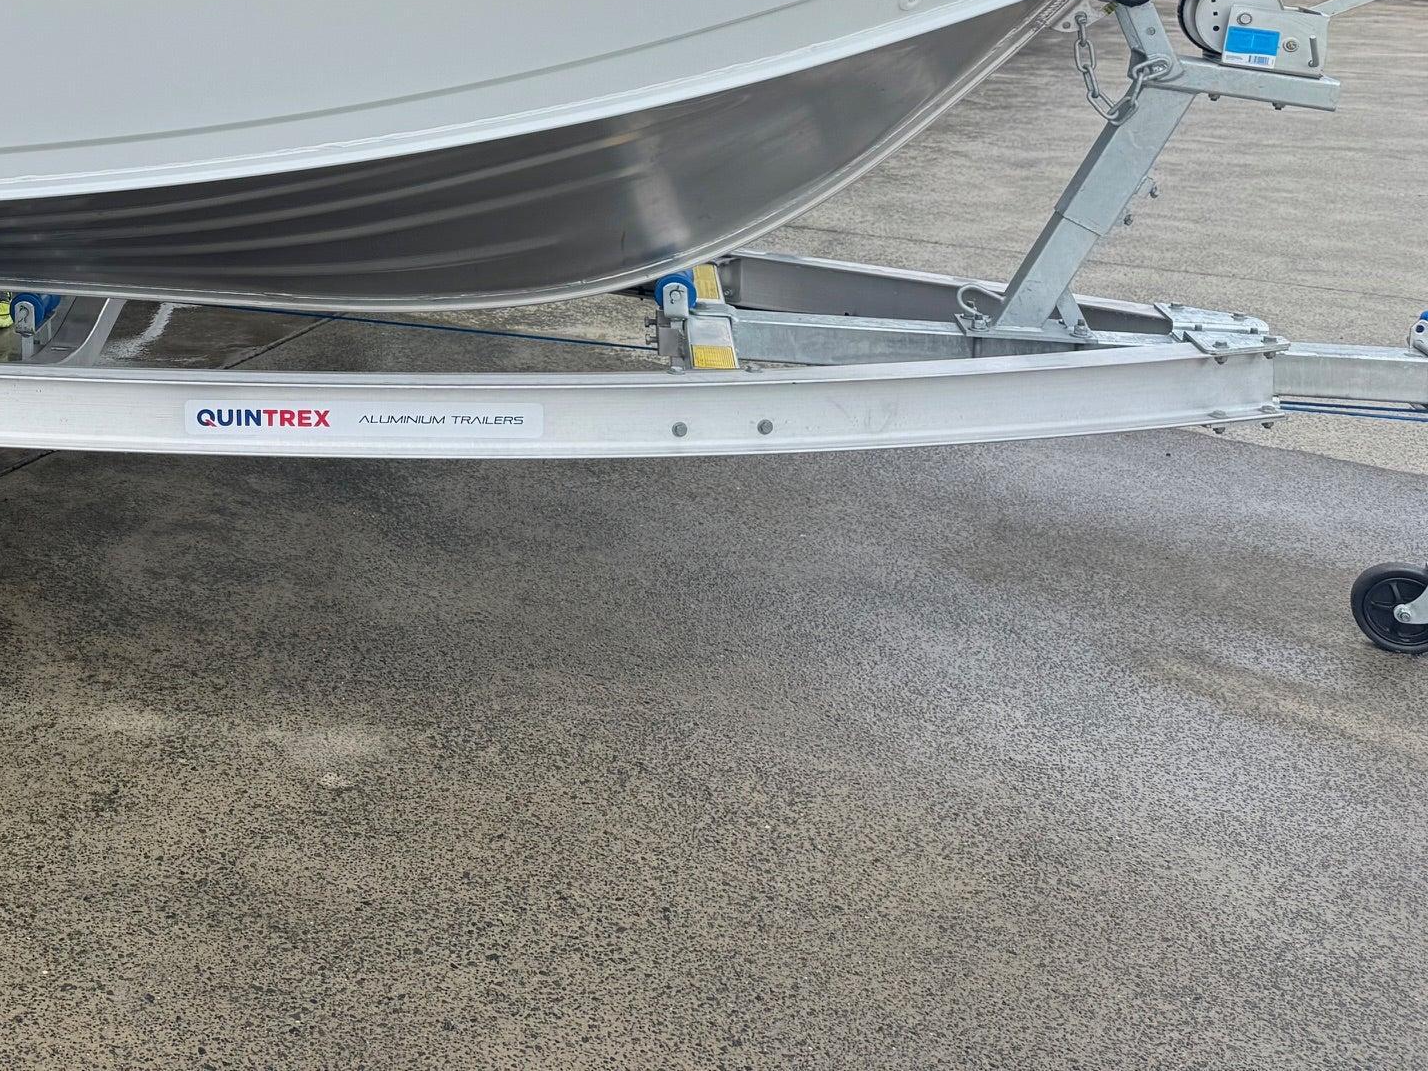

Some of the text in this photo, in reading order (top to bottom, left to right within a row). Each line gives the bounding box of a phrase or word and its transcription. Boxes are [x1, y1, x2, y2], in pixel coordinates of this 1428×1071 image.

[196, 409, 524, 428] QUINTREX ALUMINIUM TRAILERS
